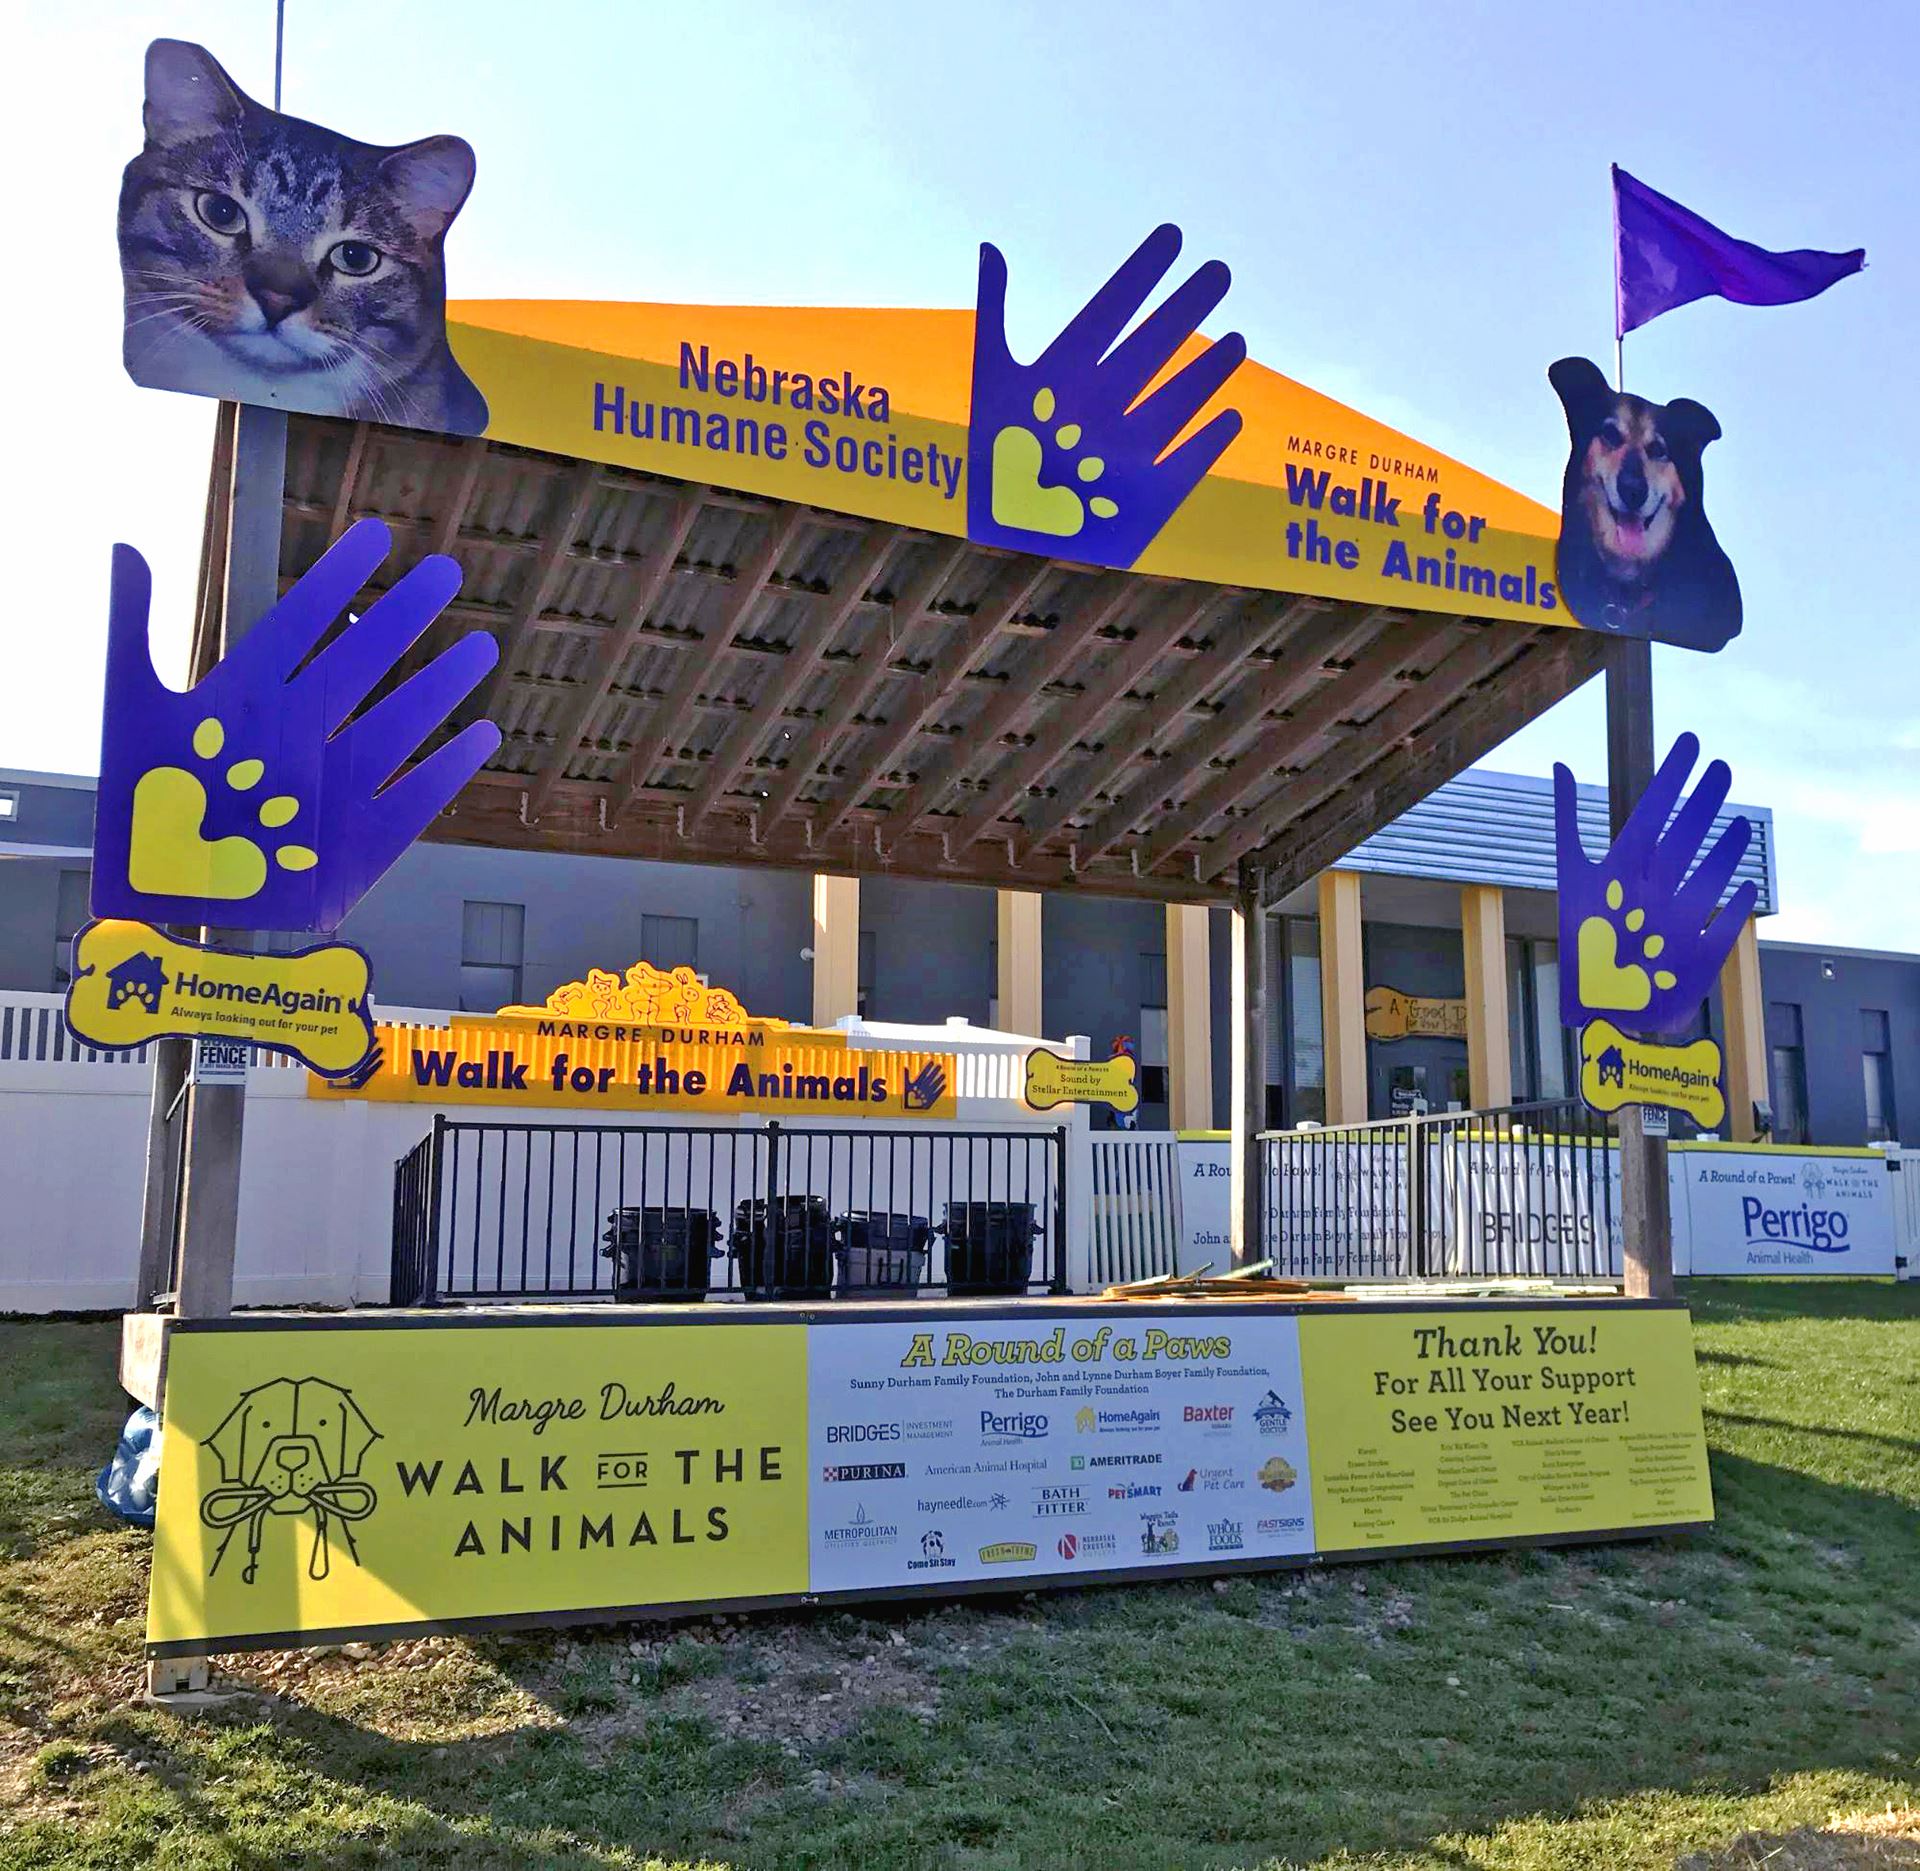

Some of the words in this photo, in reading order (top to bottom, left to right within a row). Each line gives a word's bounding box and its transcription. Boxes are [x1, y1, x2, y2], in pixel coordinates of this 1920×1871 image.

[679, 342, 890, 423] Nebraska
[593, 383, 788, 461] Humane
[804, 420, 963, 500] Society
[1288, 436, 1359, 465] MARGRE
[1370, 454, 1440, 483] DURHAM
[1285, 463, 1402, 527] Walk
[1423, 492, 1487, 544] for
[1285, 519, 1360, 570] the
[1381, 540, 1558, 610] Animals
[175, 971, 341, 1015] HomeAgain
[171, 1006, 212, 1021] Always
[215, 1011, 256, 1027] looking
[258, 1017, 276, 1028] out
[278, 1018, 293, 1029] for
[295, 1023, 319, 1033] your
[321, 1025, 338, 1035] pet
[537, 1021, 642, 1042] MARGRE
[662, 1029, 765, 1046] DURHAM
[200, 1046, 247, 1064] FENCE
[412, 1049, 530, 1090] Walk
[551, 1053, 616, 1093] for
[638, 1057, 706, 1096] the
[726, 1063, 887, 1102] Animals
[1060, 1075, 1088, 1084] Sound
[1090, 1075, 1101, 1086] by
[1629, 1059, 1709, 1088] HomeAgain
[1032, 1085, 1061, 1094] Stellar
[1062, 1086, 1128, 1098] Entertainment
[1193, 1163, 1206, 1178] A
[1208, 1163, 1232, 1178] Rou
[1699, 1170, 1709, 1183] A
[1710, 1170, 1745, 1183] Round
[1747, 1171, 1758, 1184] of
[1758, 1175, 1766, 1184] a
[1767, 1172, 1796, 1185] Paws!
[1479, 1212, 1596, 1244] BRIDGES
[1742, 1196, 1849, 1249] Perrigo
[1193, 1232, 1221, 1245] John
[1747, 1251, 1781, 1264] Animal
[1784, 1251, 1814, 1264] Health
[900, 1334, 935, 1368] A
[942, 1328, 1065, 1367] Round
[1071, 1327, 1113, 1362] of
[1113, 1336, 1138, 1361] a
[1143, 1329, 1231, 1361] Paws
[1414, 1324, 1522, 1359] Thank
[1533, 1326, 1597, 1355] You!
[850, 1378, 885, 1390] Sunny
[888, 1376, 932, 1388] Durham
[934, 1374, 970, 1388] Family
[972, 1372, 1033, 1385] Foundation,
[1035, 1371, 1060, 1382] John
[1062, 1371, 1080, 1382] and
[1082, 1370, 1112, 1383] Lynne
[1115, 1368, 1153, 1380] Durham
[1155, 1368, 1181, 1381] Boyer
[1184, 1367, 1215, 1379] Family
[1216, 1365, 1270, 1377] Foundation,
[1374, 1371, 1419, 1395] For
[1428, 1367, 1466, 1393] All
[1472, 1368, 1533, 1391] Your
[1540, 1366, 1636, 1394] Support
[995, 1388, 1014, 1399] The
[1016, 1386, 1058, 1398] Durham
[1060, 1385, 1093, 1397] Family
[1095, 1384, 1149, 1396] Foundation
[464, 1387, 586, 1435] Margre
[600, 1382, 725, 1421] Durham
[1098, 1409, 1160, 1424] HomeAgain
[1184, 1405, 1235, 1422] Baxter
[1391, 1408, 1437, 1433] See
[1445, 1406, 1494, 1430] You
[1502, 1404, 1561, 1428] Next
[1568, 1401, 1629, 1425] Year!
[906, 1420, 953, 1430] INVESTMENT
[980, 1411, 1049, 1437] Perrigo
[1260, 1419, 1287, 1428] GENTLE
[827, 1423, 901, 1443] BRIDGES
[906, 1430, 953, 1440] MANAGEMENT
[925, 1461, 971, 1475] American
[974, 1461, 1007, 1474] Animal
[1010, 1459, 1047, 1472] Hospital
[1090, 1454, 1162, 1467] AMERITRADE
[396, 1454, 568, 1498] WALK
[598, 1461, 648, 1480] FOR
[674, 1446, 782, 1485] THE
[841, 1465, 903, 1480] PURINA
[1200, 1468, 1234, 1480] Urgent
[1043, 1487, 1080, 1499] BATH
[1108, 1485, 1162, 1499] PETSMART
[1203, 1479, 1219, 1490] Pet
[1223, 1479, 1245, 1490] Care
[917, 1497, 987, 1514] hayneedle.com
[1038, 1502, 1086, 1515] FITTER
[454, 1506, 729, 1557] ANIMALS
[1207, 1520, 1244, 1535] WHOLE
[1257, 1518, 1304, 1529] FASTSIGNS
[825, 1526, 897, 1540] METROPOLITAN
[1210, 1534, 1243, 1546] FOODS
[908, 1559, 928, 1570] Come
[929, 1558, 939, 1567] Sit
[940, 1558, 956, 1568] Stay
